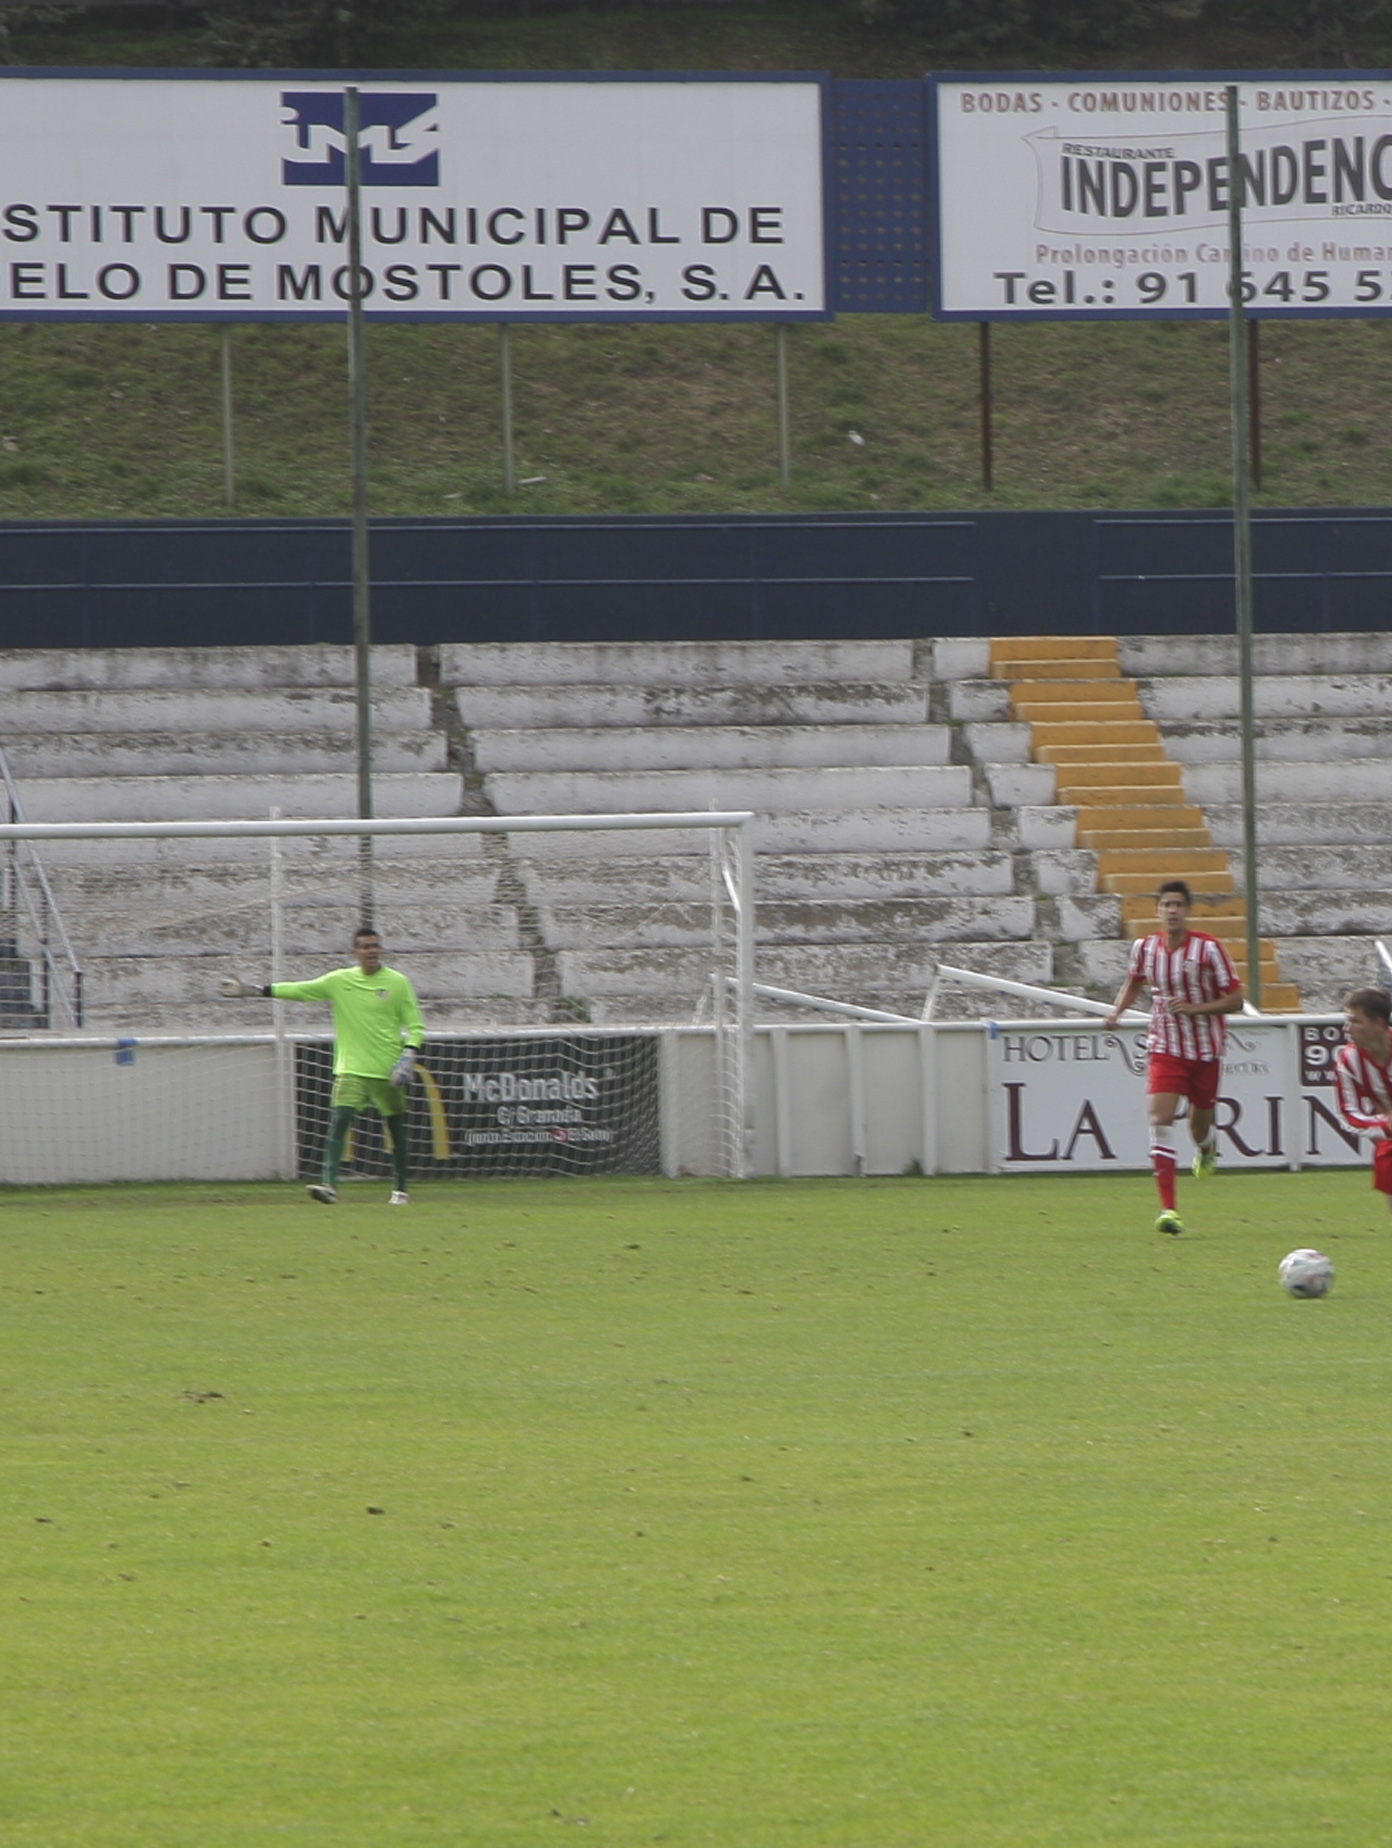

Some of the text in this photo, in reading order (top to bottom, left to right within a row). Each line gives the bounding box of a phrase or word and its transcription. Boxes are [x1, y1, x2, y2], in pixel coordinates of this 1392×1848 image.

[961, 92, 1042, 112] BODAS
[1068, 92, 1228, 112] COMUNIONES
[1256, 90, 1375, 111] BAUTIZOS
[1062, 142, 1176, 159] RESTAURANTE
[315, 206, 680, 245] MUNICIPAL
[702, 207, 785, 244] DE
[1036, 244, 1188, 268] Prolongación
[1287, 242, 1314, 262] de
[167, 264, 252, 300] DE
[277, 263, 655, 304] MOSTOLES,
[994, 270, 1115, 304] Tel.:
[1136, 271, 1198, 304] 91
[1226, 269, 1331, 304] 645
[1002, 1034, 1109, 1061] HOTEL
